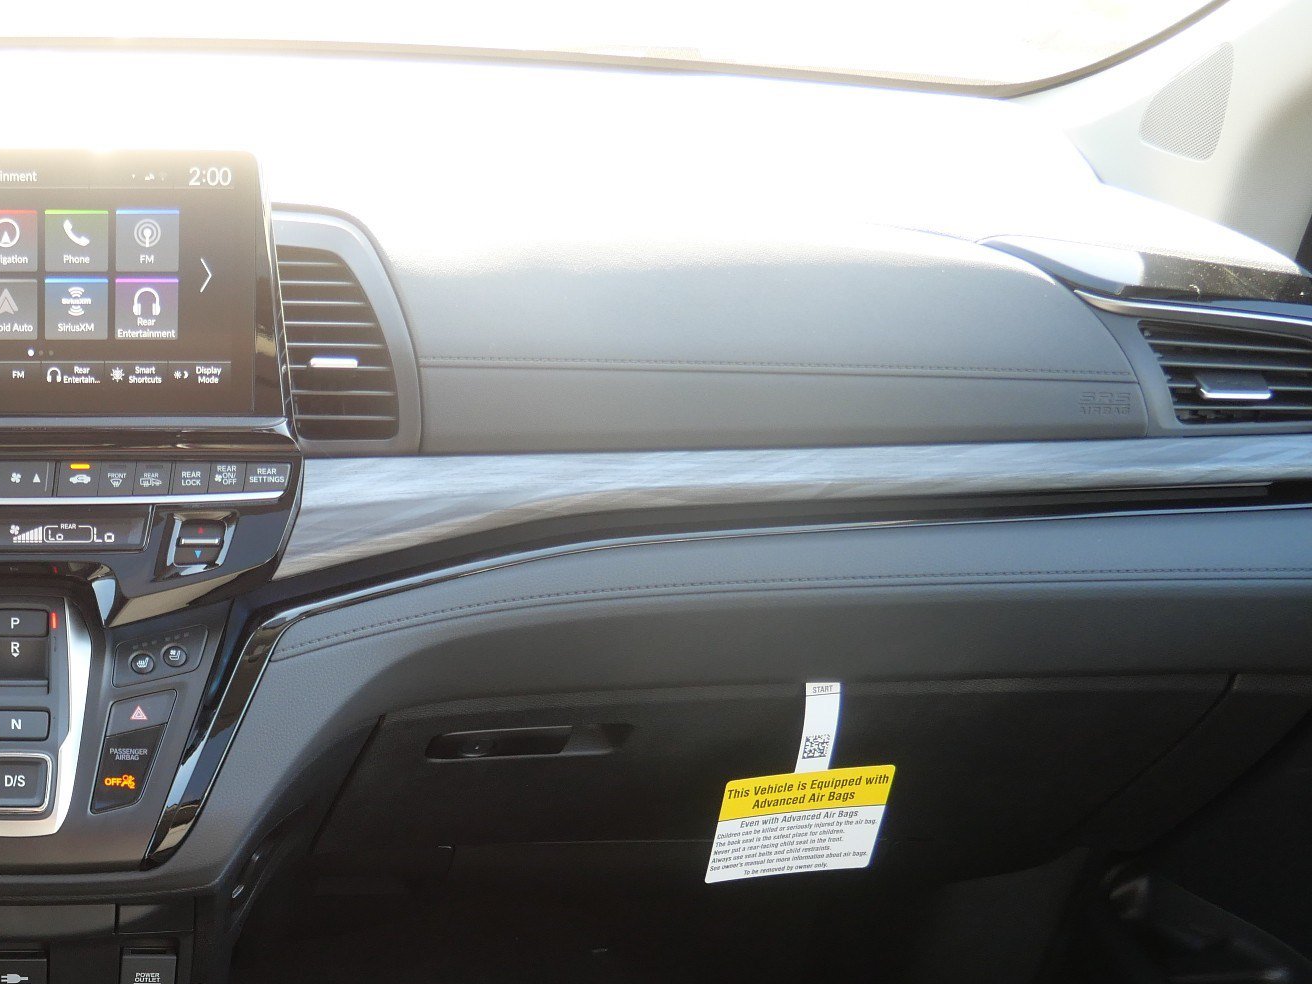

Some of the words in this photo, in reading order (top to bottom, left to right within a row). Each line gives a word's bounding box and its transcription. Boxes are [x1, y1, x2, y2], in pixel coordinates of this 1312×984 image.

[188, 167, 232, 186] 2:00
[63, 254, 90, 264] Phone
[139, 254, 154, 264] FM
[137, 317, 155, 327] Rear
[12, 323, 33, 333] Auto
[57, 323, 95, 333] SiriusXM
[117, 329, 175, 339] Entertainment
[12, 371, 25, 379] FM
[74, 366, 90, 374] Rear
[135, 366, 155, 374] Smart
[196, 366, 222, 376] Display
[128, 376, 162, 384] Shortcuts
[198, 376, 219, 384] Mode
[48, 530, 64, 541] Lo
[93, 527, 115, 543] Lo
[10, 617, 20, 629] P
[10, 641, 20, 653] R
[812, 685, 833, 693] START
[11, 719, 22, 730] N
[4, 775, 26, 787] D/S
[104, 777, 122, 786] OFF
[728, 788, 750, 800] This
[754, 782, 794, 796] Vehicle
[797, 781, 807, 790] is
[810, 776, 862, 791] Equipped
[865, 774, 889, 785] with
[752, 794, 805, 809] Advanced
[808, 793, 825, 803] Air
[828, 791, 855, 802] Bags
[740, 820, 760, 828] Even
[762, 816, 779, 825] with
[781, 812, 821, 823] Advanced
[823, 811, 836, 819] Air
[838, 810, 858, 818] Bags
[711, 856, 732, 864] Always
